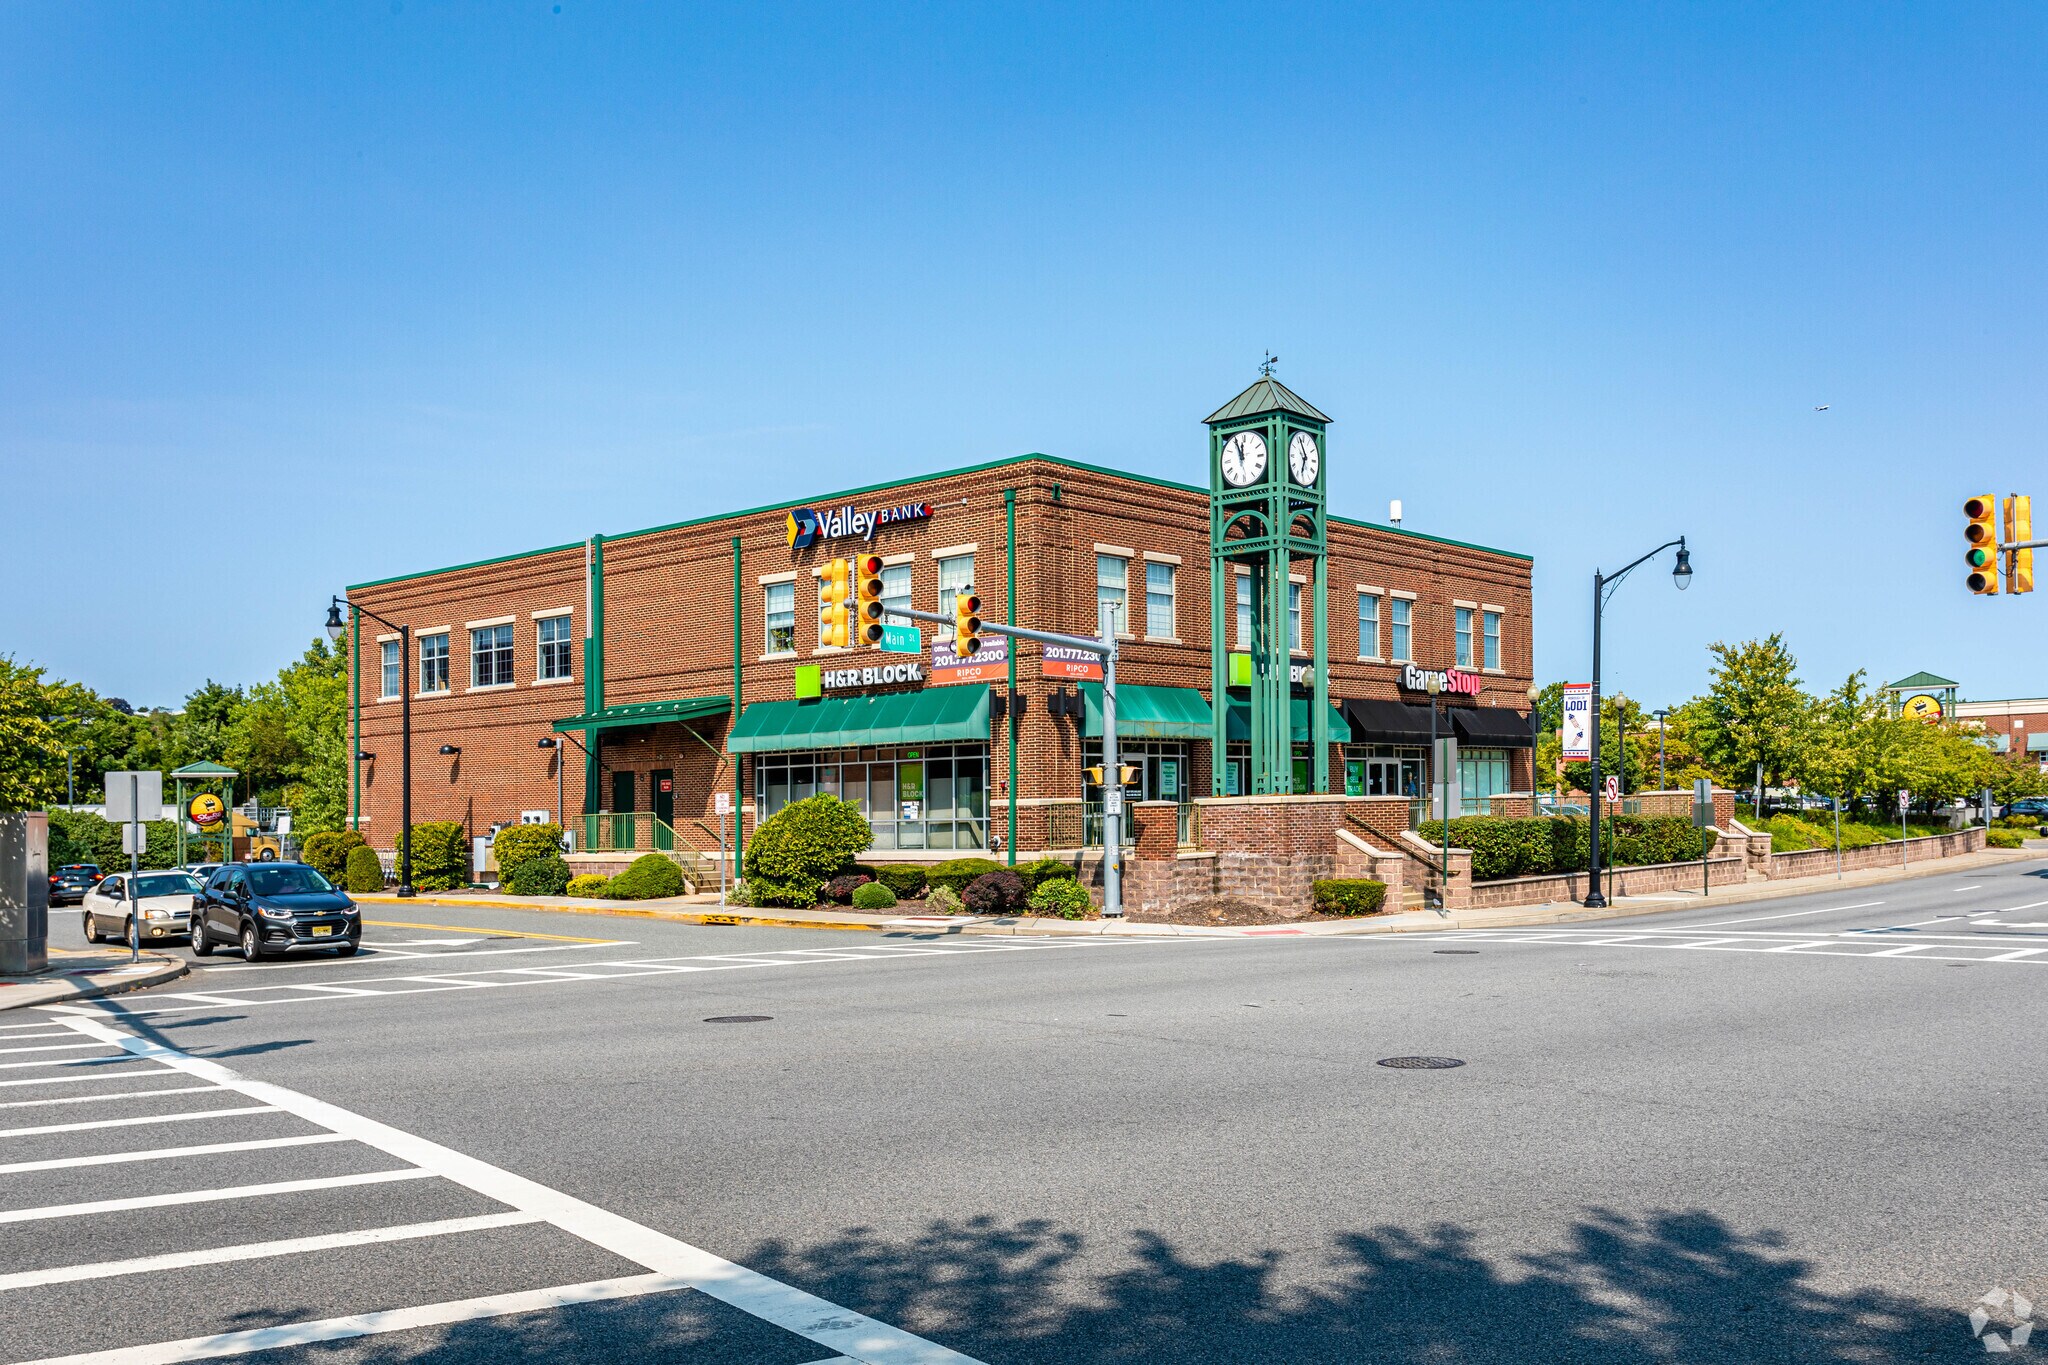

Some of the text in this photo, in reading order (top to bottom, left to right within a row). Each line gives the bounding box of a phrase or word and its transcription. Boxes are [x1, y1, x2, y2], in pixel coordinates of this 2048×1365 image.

[817, 502, 924, 541] Valley BANK
[885, 631, 916, 646] Main St
[1045, 646, 1101, 661] 201.777.230
[956, 667, 982, 678] RIPCO
[1065, 663, 1089, 673] RIPCO
[824, 662, 923, 689] H&R BLOCK
[1405, 665, 1481, 697] GameStop
[1566, 700, 1587, 711] LODI
[1349, 765, 1359, 773] BUY
[902, 790, 924, 798] BLOCK
[1347, 785, 1362, 793] TRADE
